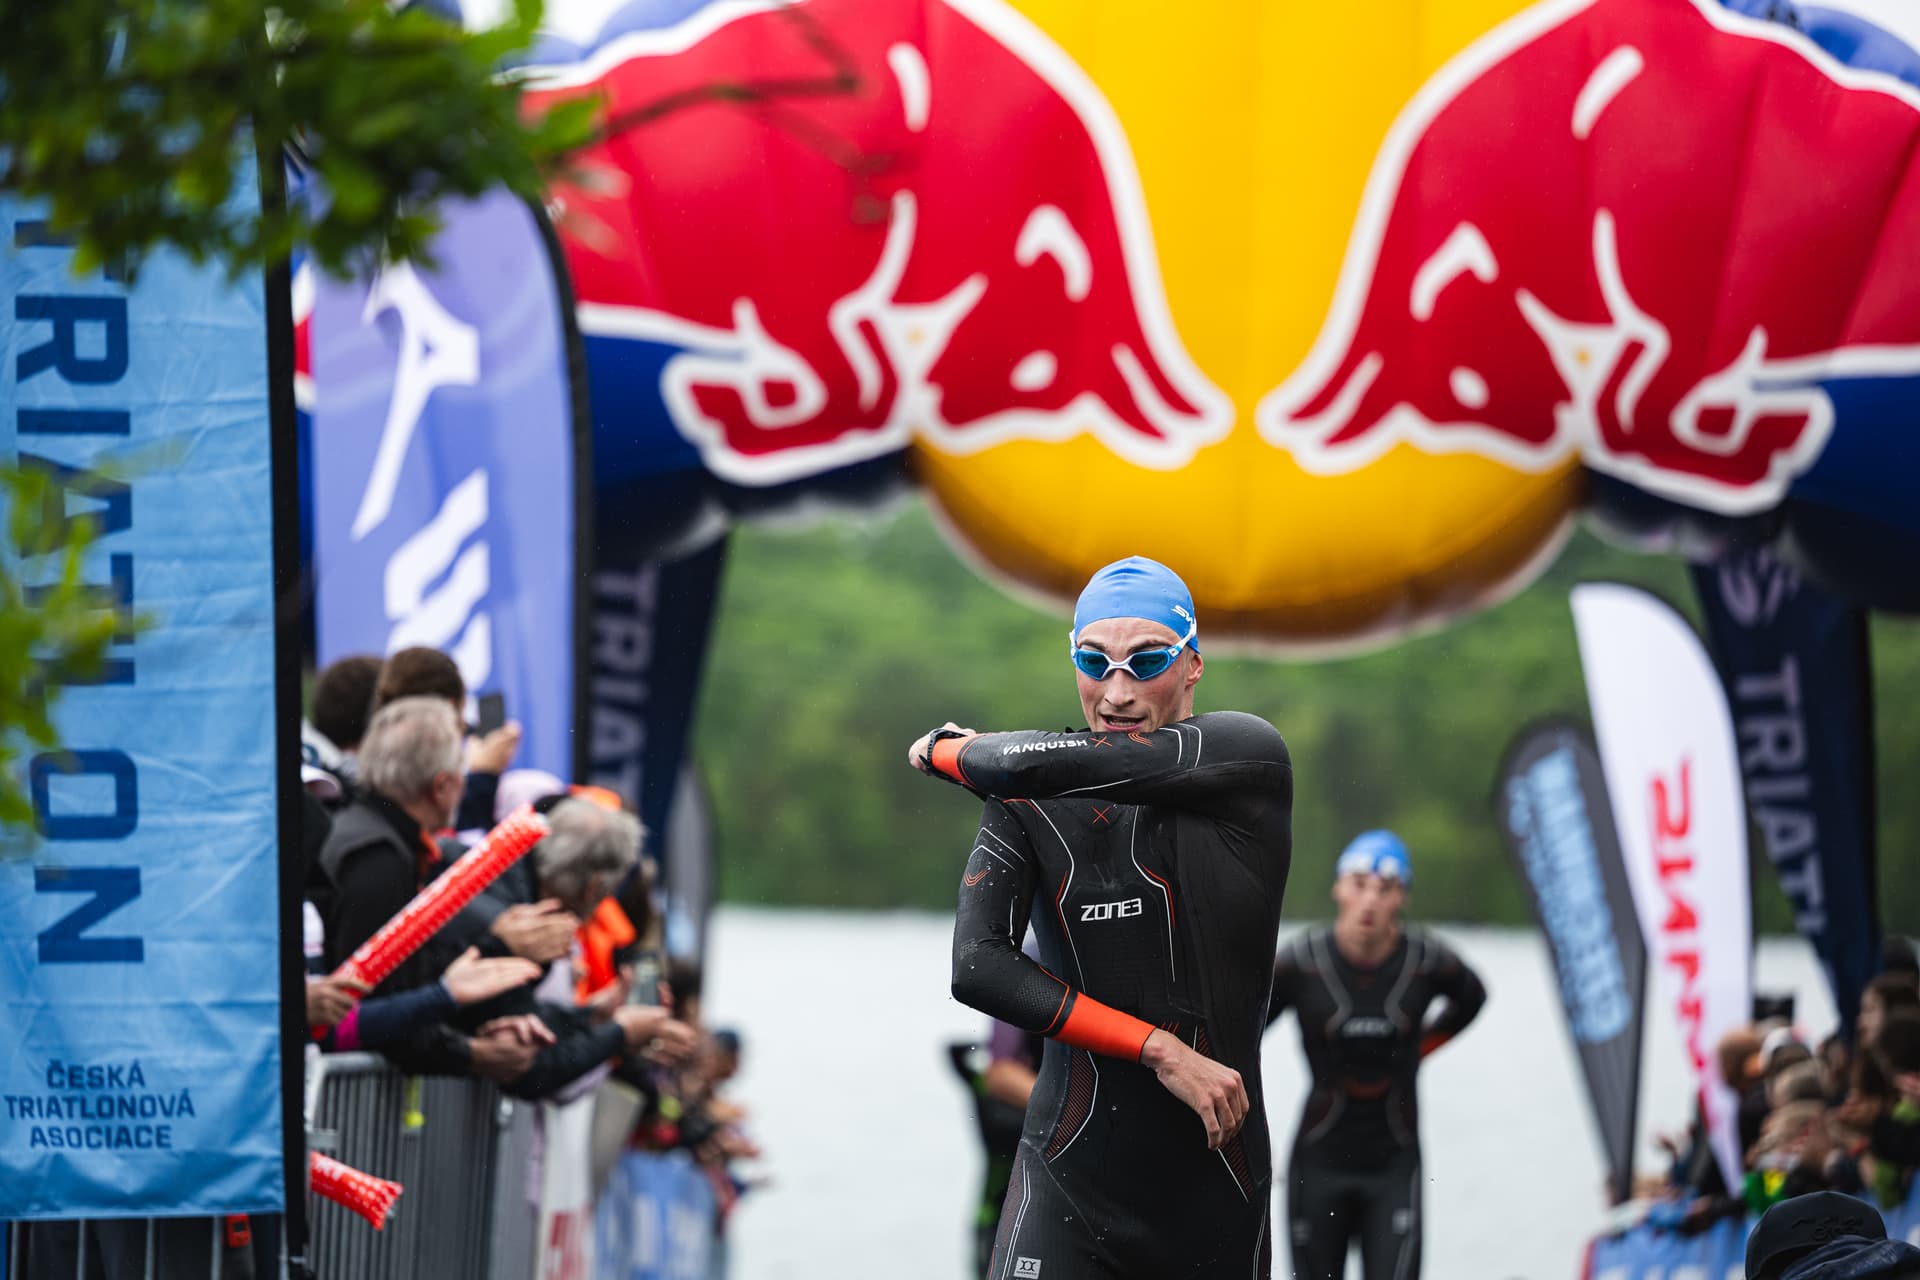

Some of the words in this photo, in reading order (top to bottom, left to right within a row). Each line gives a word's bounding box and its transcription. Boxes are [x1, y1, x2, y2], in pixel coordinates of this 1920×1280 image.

[1002, 738, 1088, 756] VANQUISH
[1080, 897, 1143, 922] ZONE3
[46, 1058, 146, 1090] ČESKÁ
[3, 1087, 196, 1121] TRIATLONOVÁ
[30, 1124, 172, 1150] ASOCIACE
